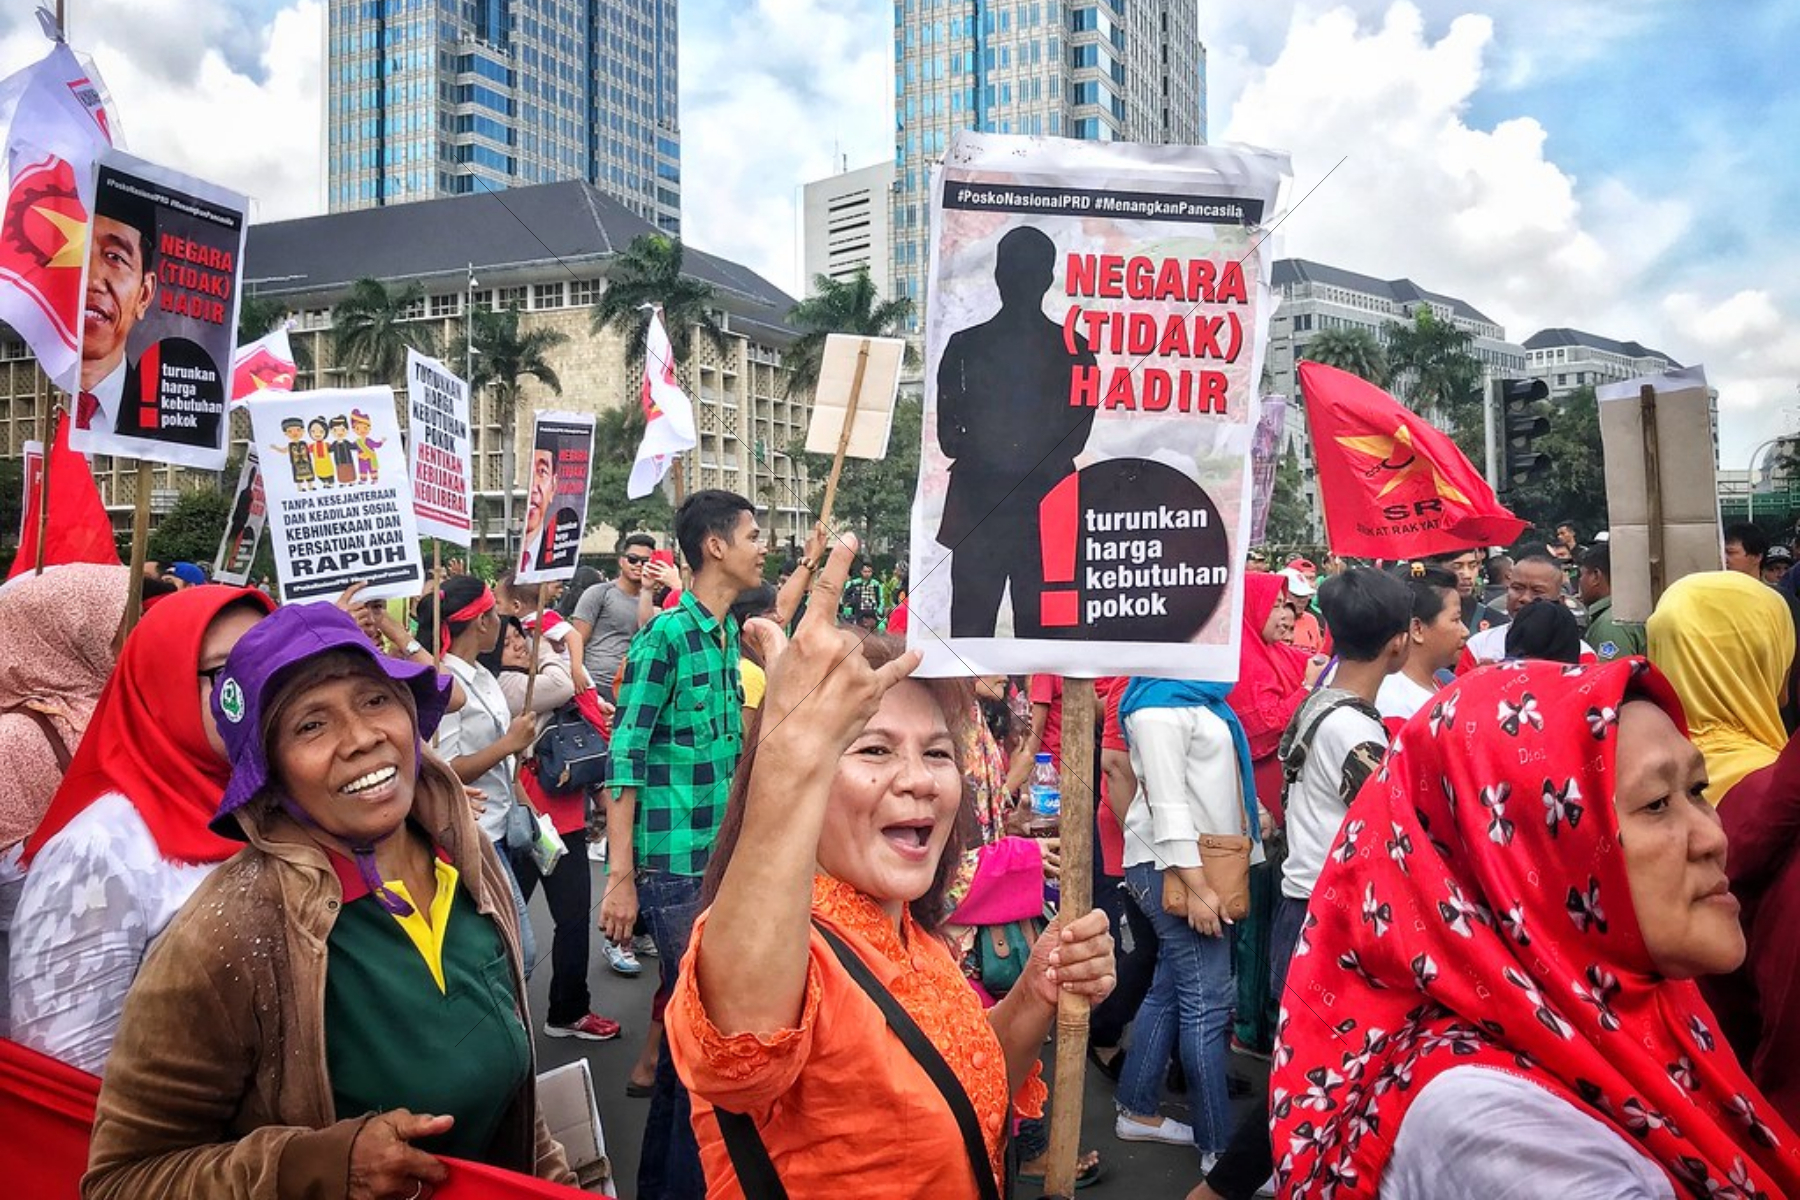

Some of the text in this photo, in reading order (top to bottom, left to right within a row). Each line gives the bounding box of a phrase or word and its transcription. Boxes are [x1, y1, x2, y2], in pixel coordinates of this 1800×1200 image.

[957, 190, 1243, 218] #PoskoNasionalPRD #MenangkanPancasila
[160, 233, 233, 272] NEGARA
[158, 258, 230, 301] (TIDAK)
[1065, 253, 1248, 304] NEGARA
[160, 287, 225, 325] HADIR
[1063, 304, 1243, 364] (TIDAK)
[162, 363, 216, 382] turunkan
[161, 379, 197, 397] harga
[424, 386, 455, 416] HARGA
[1069, 365, 1228, 414] HADIR
[161, 395, 222, 413] kebutuhan
[161, 412, 198, 429] pokok
[413, 400, 467, 439] KEBUTUHAN
[425, 425, 456, 454] POKOK
[418, 442, 463, 475] HENTIKAN
[416, 460, 466, 495] KEBIJAKAN
[281, 488, 397, 511] TANPA KESEJAHTERAAN
[415, 480, 468, 515] NEOLIBERAL
[1383, 499, 1442, 520] SR
[283, 513, 307, 525] DAN
[309, 507, 360, 522] KEADILAN
[363, 501, 398, 516] SOSIAL
[1085, 505, 1208, 531] turunkan
[286, 519, 373, 541] KEBHINEKAAN
[375, 515, 401, 530] DAN
[288, 530, 404, 558] PERSATUAN AKAN
[291, 545, 407, 567] RAPUH
[1086, 537, 1163, 564] harga
[1086, 562, 1229, 590] kebutuhan
[1086, 592, 1168, 624] pokok
